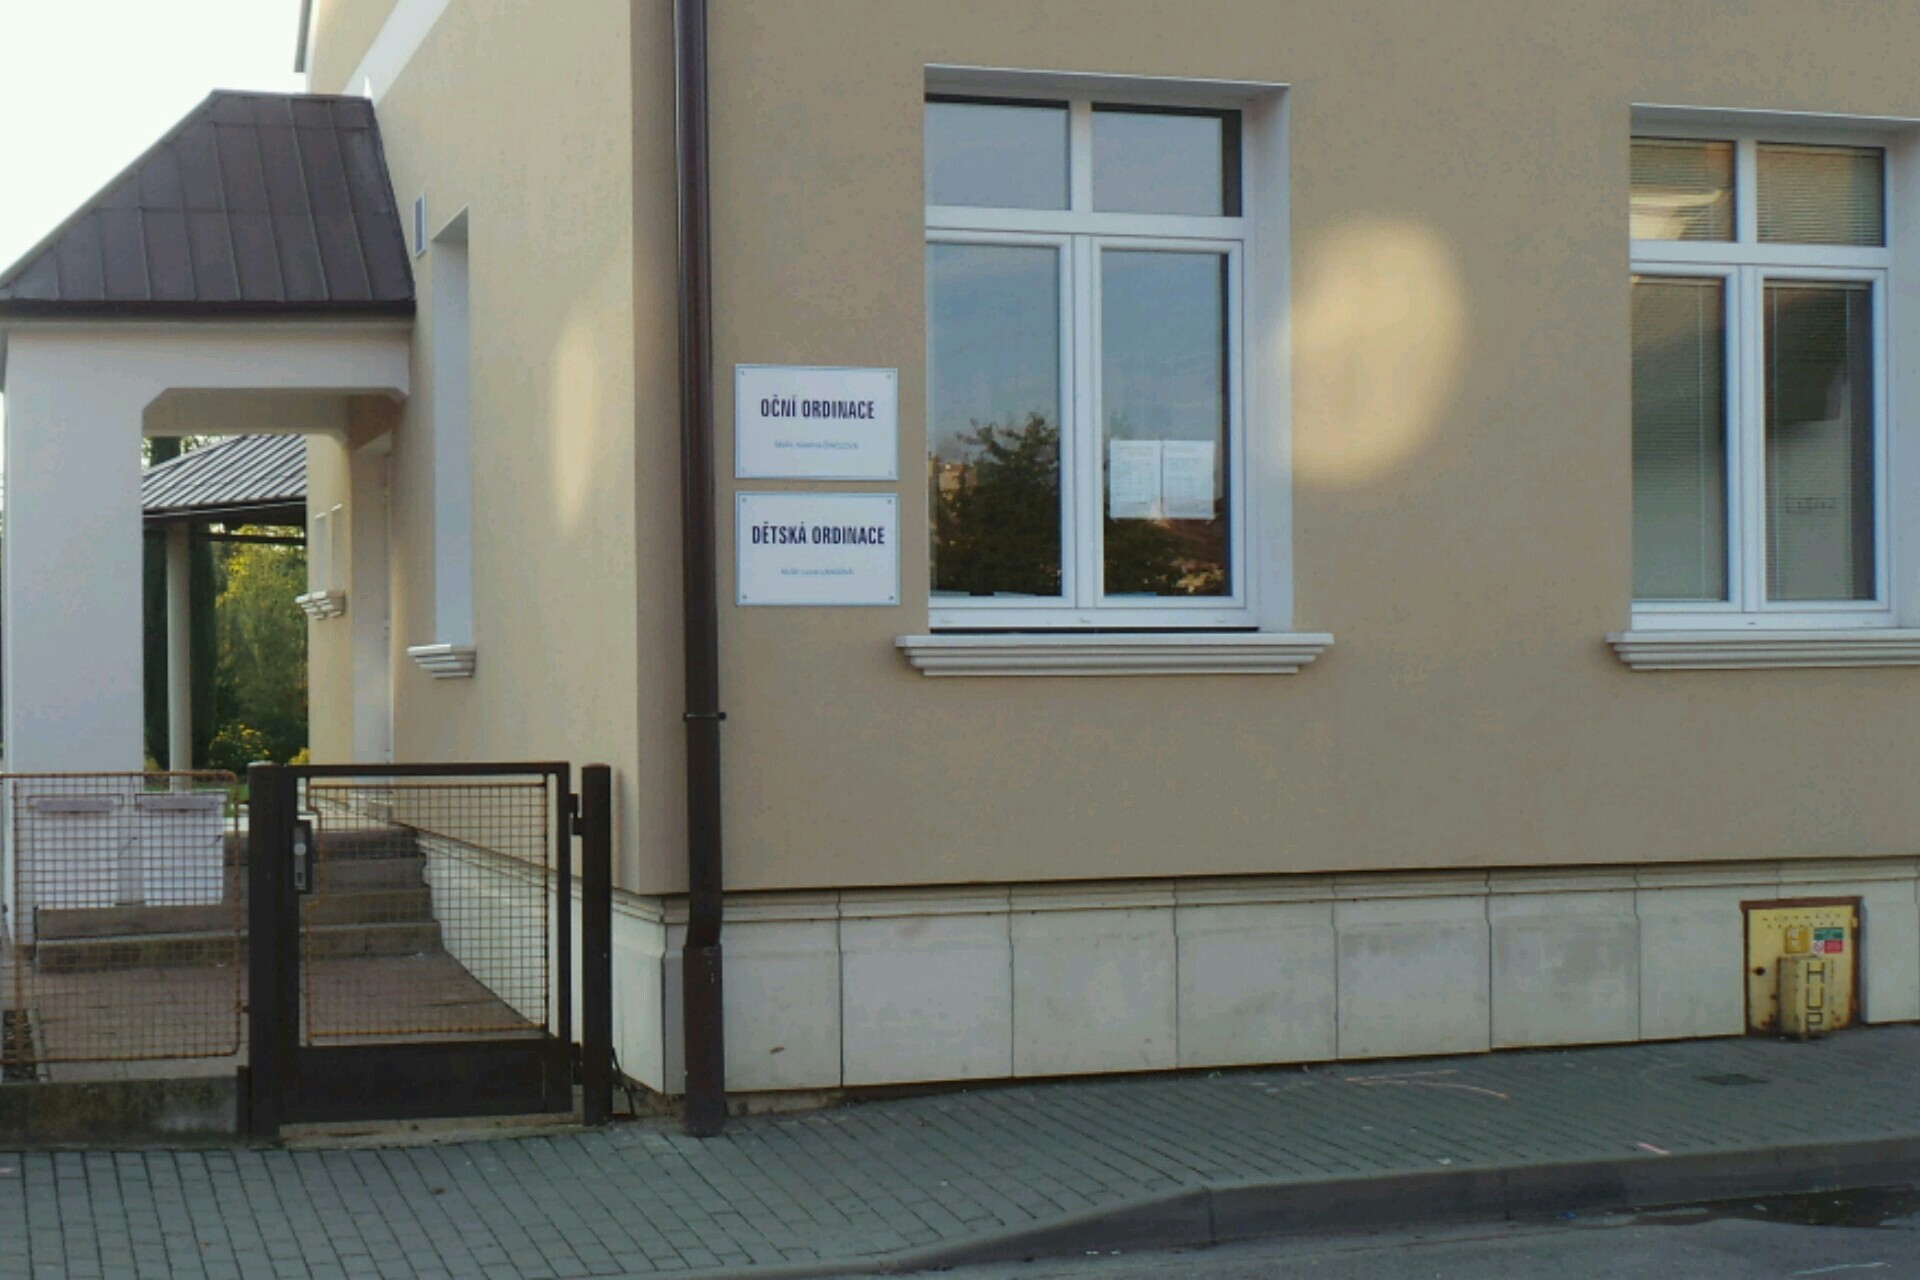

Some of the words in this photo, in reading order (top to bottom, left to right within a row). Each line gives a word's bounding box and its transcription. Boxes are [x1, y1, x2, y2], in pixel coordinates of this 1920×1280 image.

[761, 394, 797, 417] OČNÍ
[802, 399, 875, 419] ORDINACE
[752, 521, 807, 544] DĚTSKÁ
[811, 525, 885, 544] ORDINACE
